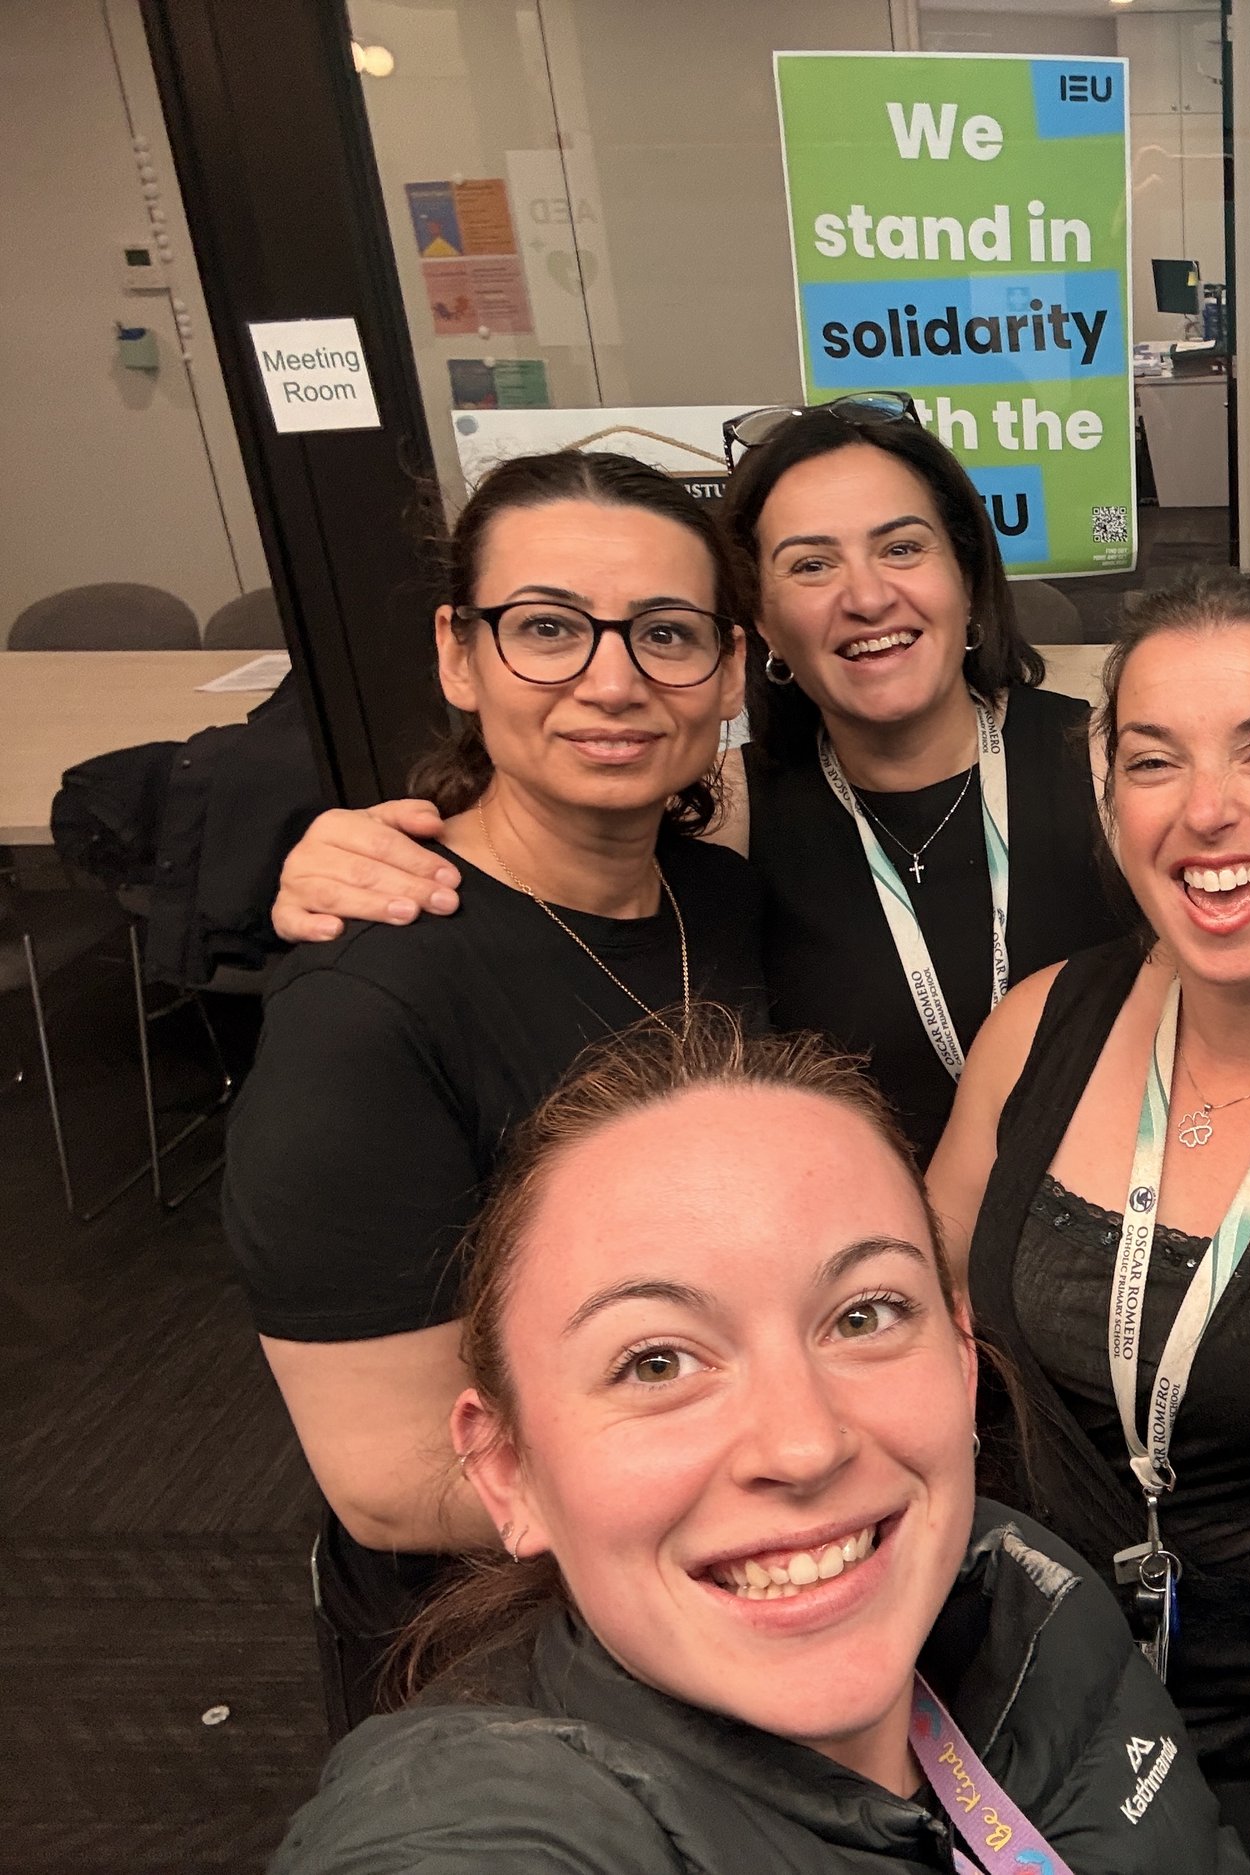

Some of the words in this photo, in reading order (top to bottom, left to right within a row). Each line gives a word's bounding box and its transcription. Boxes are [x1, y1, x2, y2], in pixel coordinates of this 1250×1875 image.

[1060, 75, 1112, 102] IEU
[886, 102, 1004, 161] We
[814, 204, 1011, 262] stand
[1029, 200, 1092, 262] in
[822, 298, 1108, 366] solidarity
[263, 347, 360, 373] Meeting
[283, 380, 356, 404] Room
[992, 398, 1103, 450] the
[911, 970, 937, 1026] ROMERO
[923, 967, 938, 997] SCHOOL
[934, 999, 950, 1030] PRIMARY
[931, 1026, 955, 1065] OSCAR
[944, 1031, 962, 1065] CATHOLIC
[1120, 1224, 1134, 1273] CATHOLIC
[1130, 1226, 1148, 1282] OSCAR
[1115, 1275, 1126, 1316] PRIMARY
[1123, 1286, 1140, 1360] ROMERO
[1153, 1376, 1170, 1444] ROMERO
[1169, 1383, 1181, 1419] SCHOOL
[938, 1742, 981, 1813] Kind
[1120, 1736, 1178, 1825] Kathmandu
[981, 1807, 1012, 1852] Be
